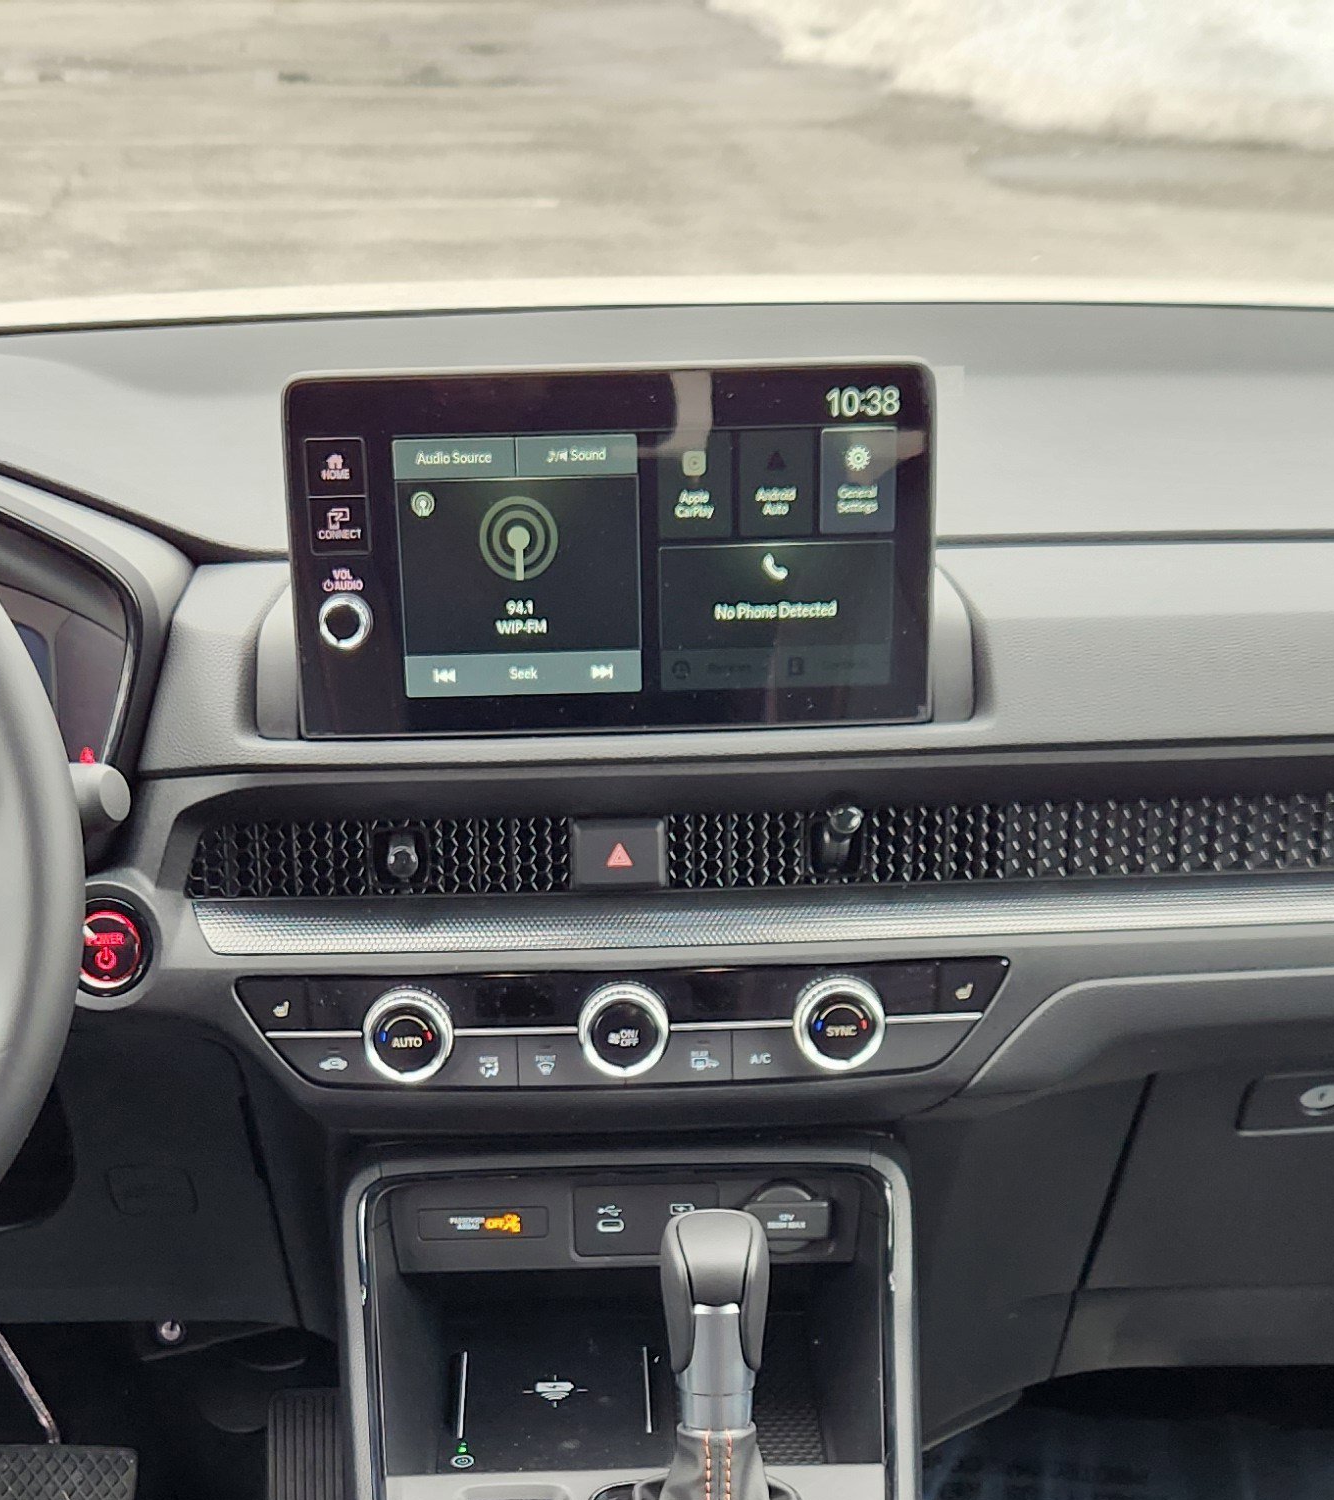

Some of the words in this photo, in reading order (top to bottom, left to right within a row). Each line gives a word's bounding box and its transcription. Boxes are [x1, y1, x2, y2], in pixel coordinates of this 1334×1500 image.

[826, 385, 900, 417] 10:38
[416, 452, 450, 464] Audio
[452, 451, 492, 464] Source
[570, 448, 606, 461] Sound
[321, 468, 350, 480] HOME
[679, 489, 710, 504] Apple
[756, 486, 797, 502] Android
[674, 504, 715, 519] CarPlay
[762, 502, 789, 516] Auto
[318, 528, 362, 541] CONNECT
[332, 569, 353, 580] VOL
[334, 579, 364, 591] AUDIO
[505, 601, 534, 615] 94.1
[714, 603, 735, 620] No
[737, 602, 777, 619] Phone
[778, 600, 838, 618] Detected
[495, 619, 548, 634] WIP-FM
[509, 667, 538, 680] Seek
[825, 1026, 858, 1037] SYNC
[391, 1037, 423, 1049] AUTO
[750, 1053, 771, 1065] A/C
[485, 1218, 504, 1229] OFF
